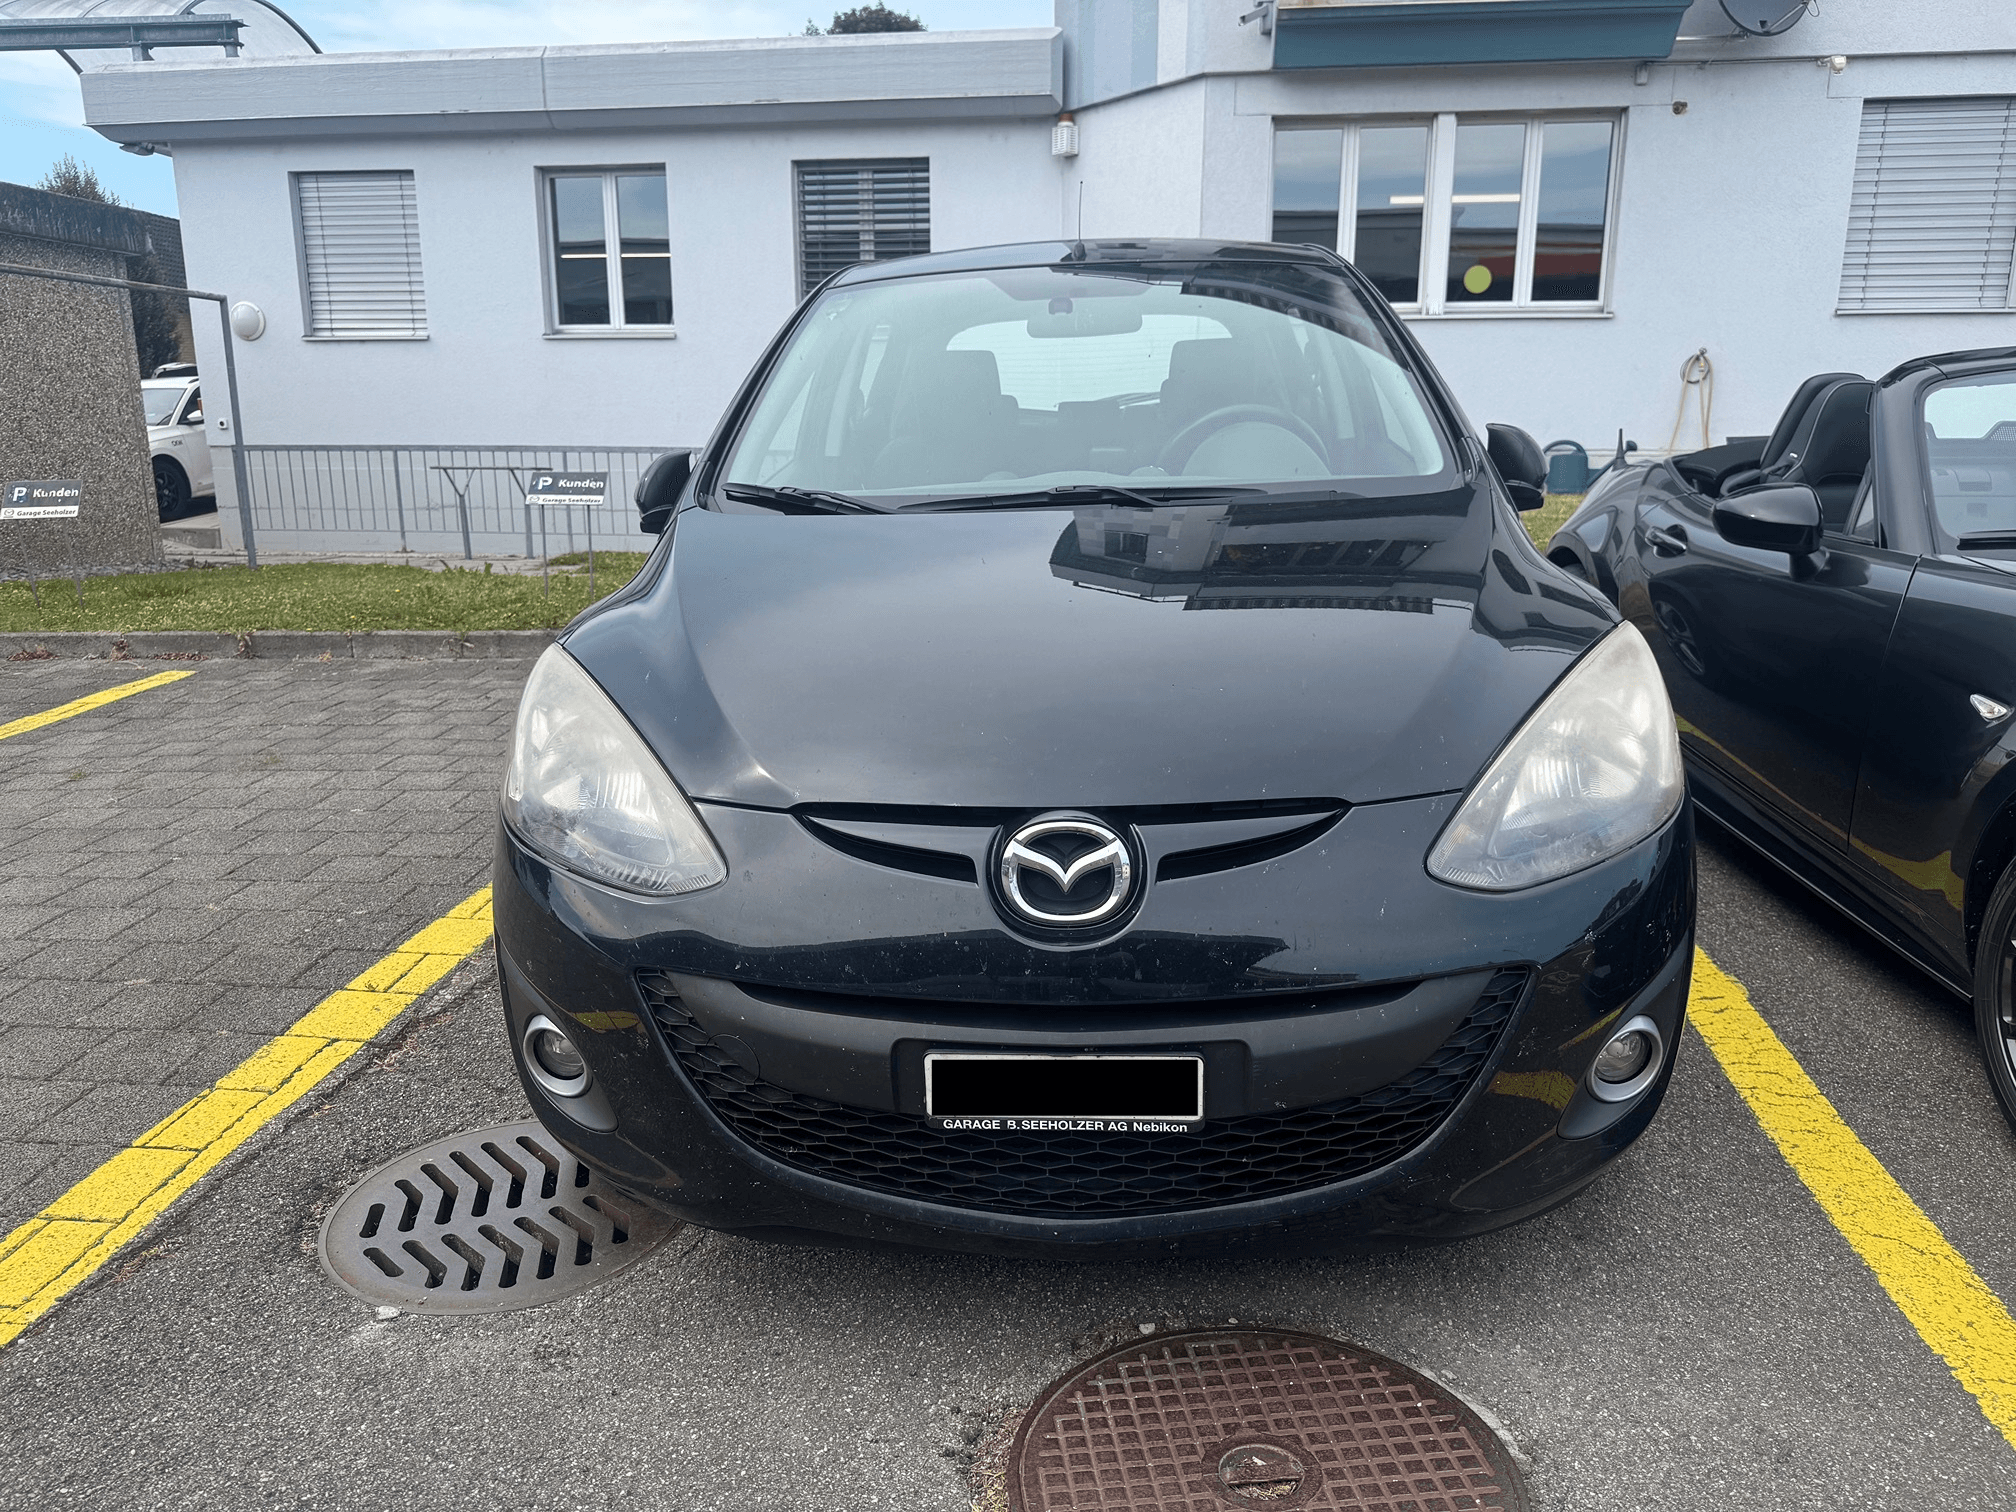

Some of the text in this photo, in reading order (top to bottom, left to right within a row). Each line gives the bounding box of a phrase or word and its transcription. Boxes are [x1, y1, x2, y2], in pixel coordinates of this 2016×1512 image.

[538, 477, 604, 490] P Kunden
[12, 487, 79, 501] P Kunden
[943, 1119, 1001, 1130] GARAGE
[1108, 1121, 1128, 1131] AG
[1133, 1122, 1188, 1133] Nebikon
